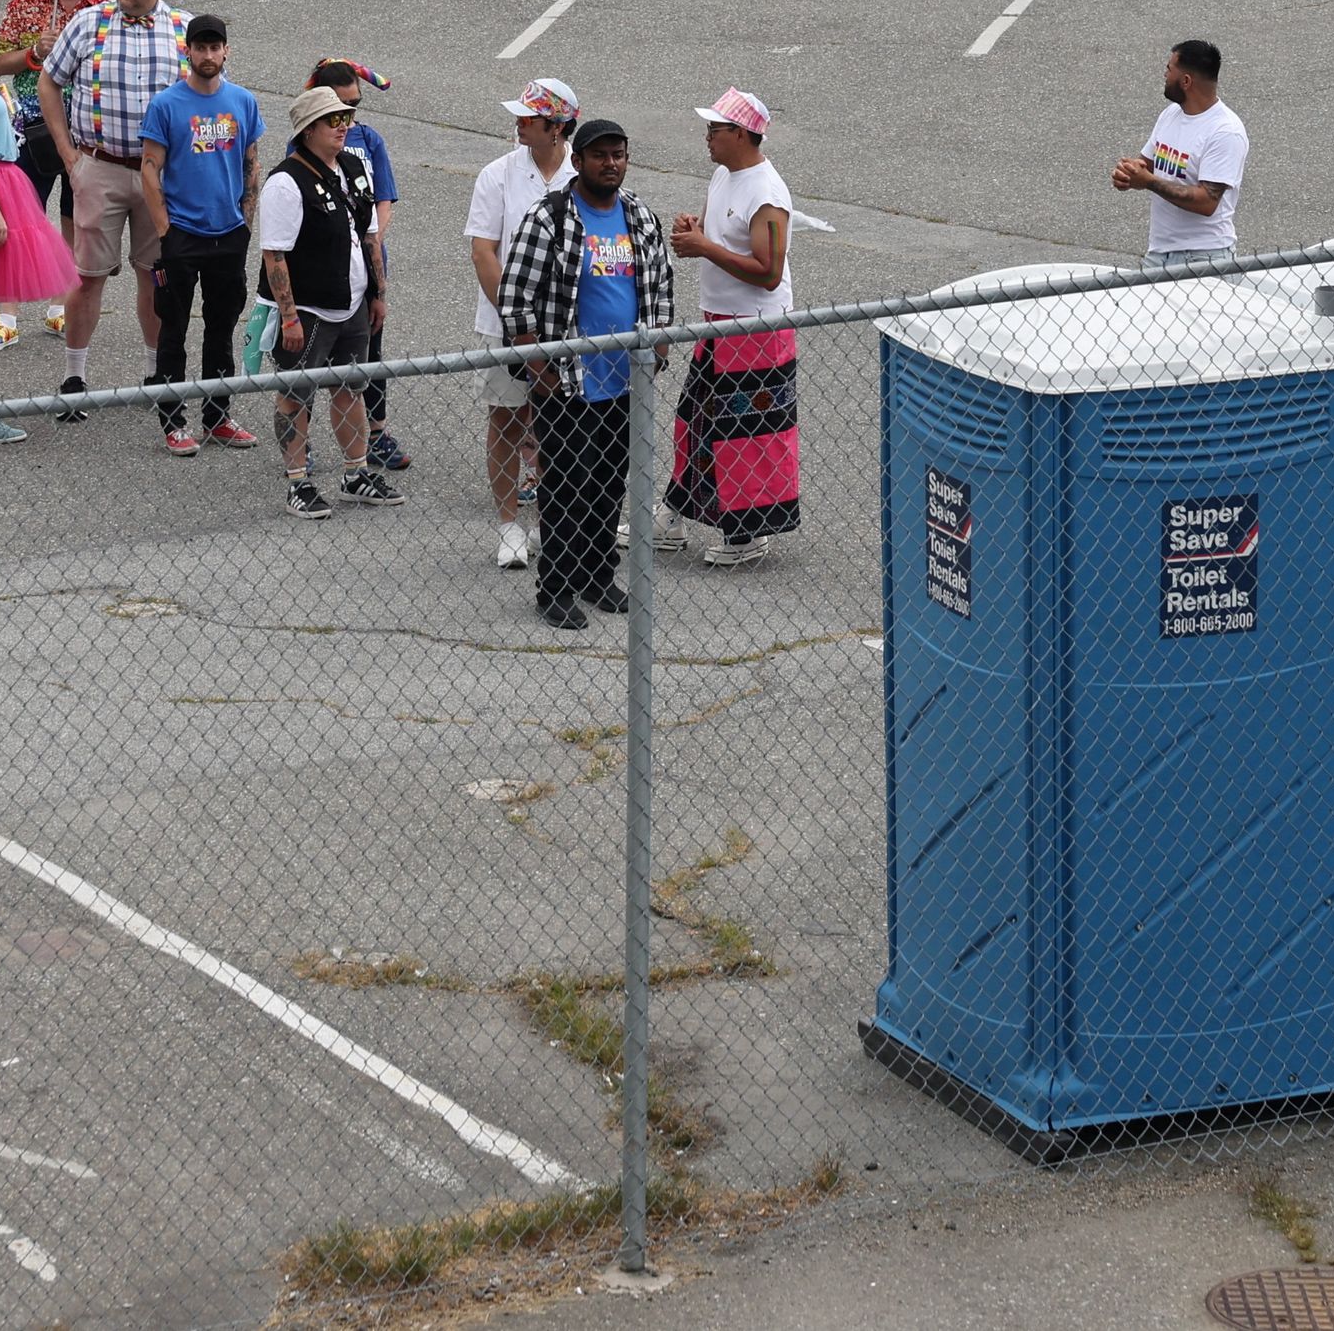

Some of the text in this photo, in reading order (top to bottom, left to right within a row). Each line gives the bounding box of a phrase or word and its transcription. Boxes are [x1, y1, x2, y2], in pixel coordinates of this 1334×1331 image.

[199, 123, 229, 136] PRIDE
[599, 245, 630, 258] PRIDE
[928, 471, 965, 509] Super
[928, 496, 958, 527] Save
[1170, 504, 1244, 532] Super
[928, 532, 958, 565] Toilet
[1170, 530, 1229, 552] Save
[928, 556, 968, 593] Rentals
[1167, 566, 1228, 589] Toilet
[1167, 587, 1250, 614] Rentals
[1164, 611, 1256, 636] 1-800-665-2800
